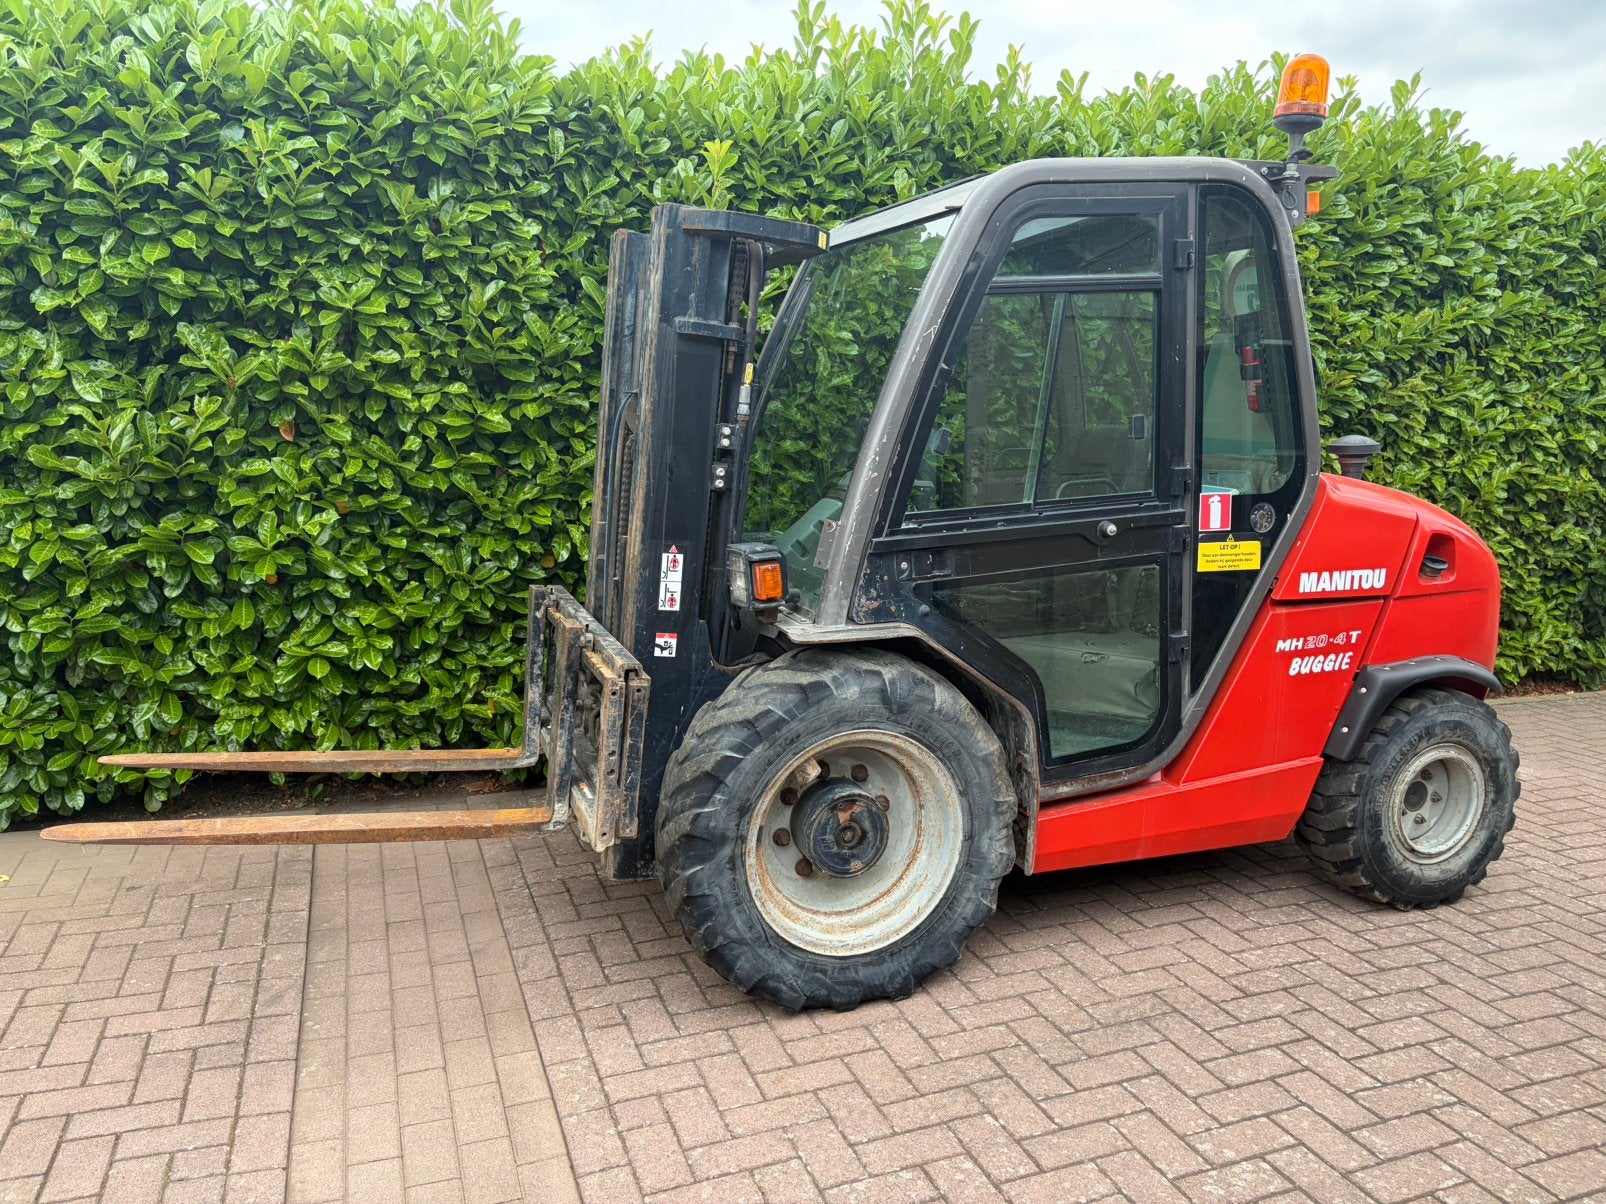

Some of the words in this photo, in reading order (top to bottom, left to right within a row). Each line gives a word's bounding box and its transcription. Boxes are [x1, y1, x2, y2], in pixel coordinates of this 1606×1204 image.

[1299, 568, 1387, 593] MANITOU
[1275, 637, 1304, 652] MH
[1288, 651, 1354, 676] BUGGIE
